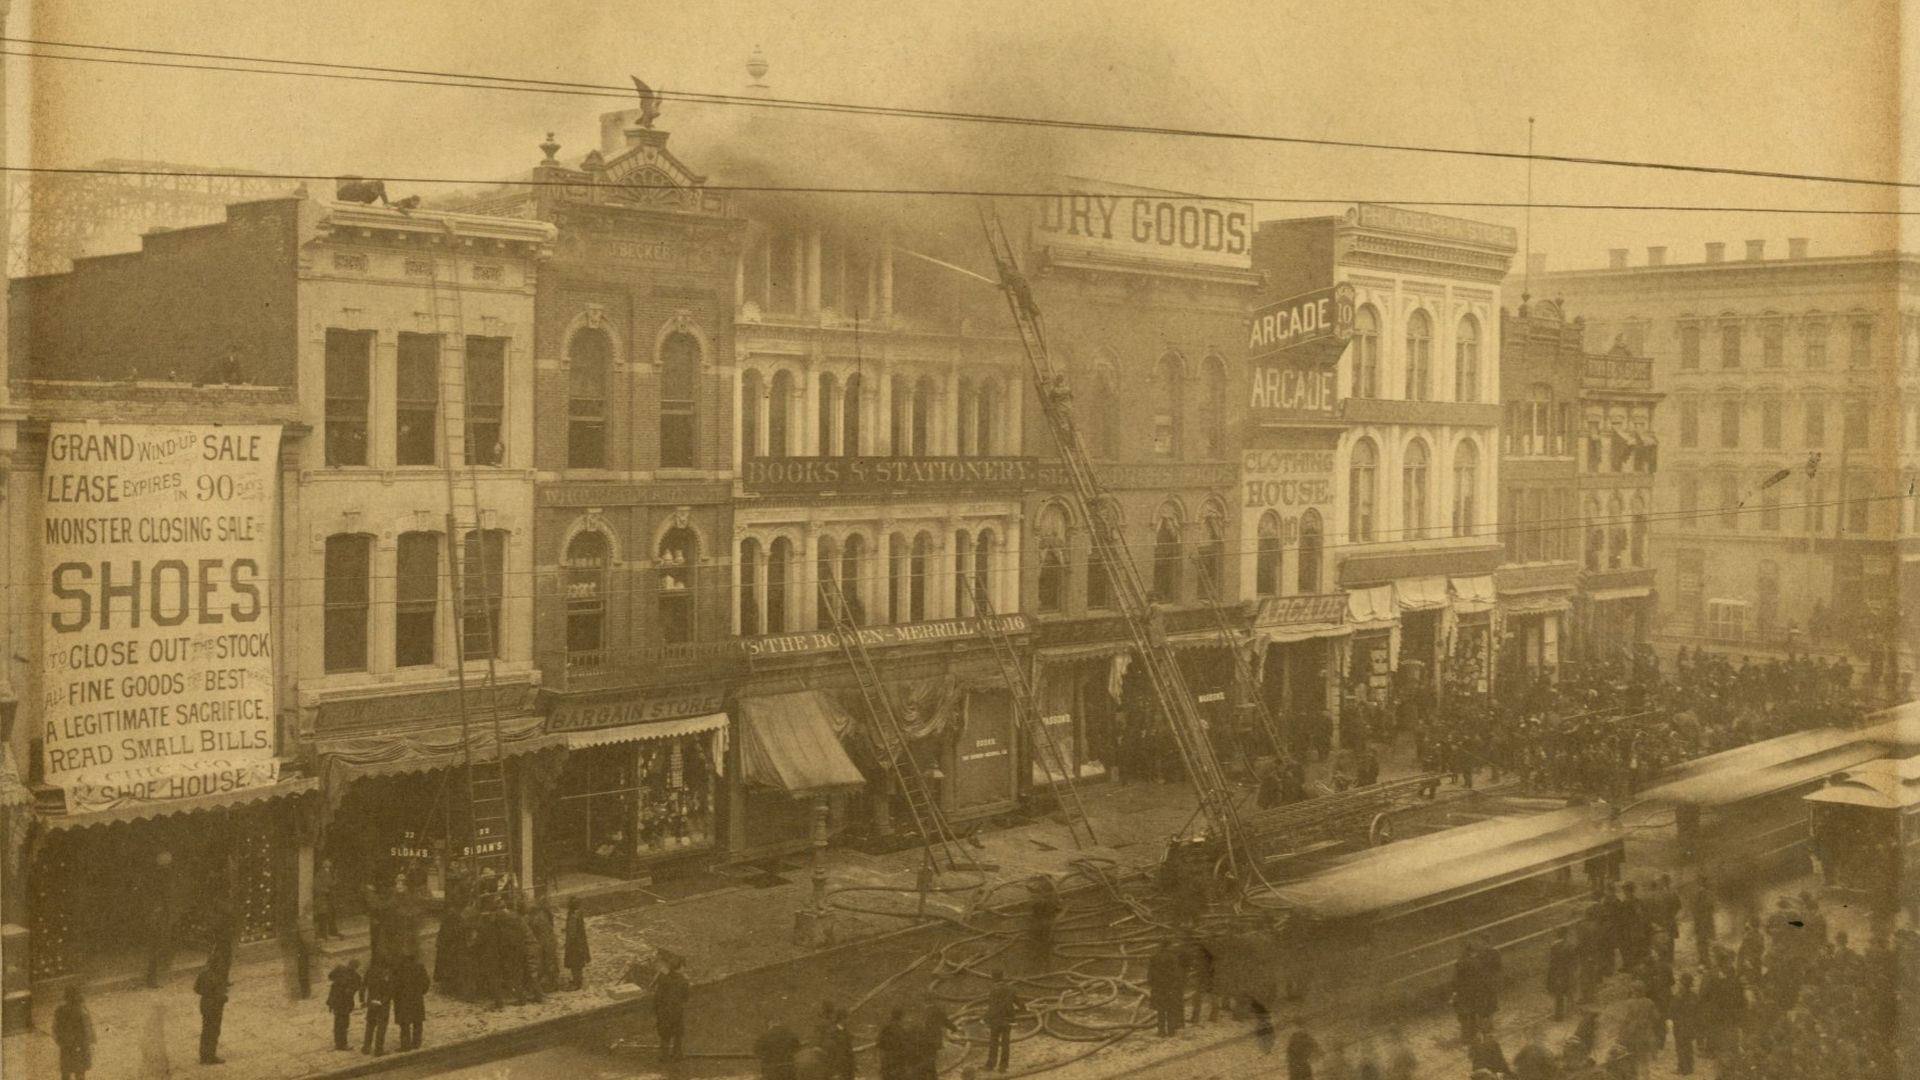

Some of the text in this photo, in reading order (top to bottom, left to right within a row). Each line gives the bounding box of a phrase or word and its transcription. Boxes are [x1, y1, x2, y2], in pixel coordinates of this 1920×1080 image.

[1037, 187, 1121, 240] DRY
[1249, 298, 1331, 349] ARCADE
[1337, 303, 1353, 323] 10
[1250, 367, 1333, 411] ARCADE
[51, 434, 261, 462] GRAND WIND-UP SALE
[1244, 452, 1334, 474] CLOTHING
[47, 474, 119, 502] LEASE
[123, 473, 182, 498] EXPIRES
[197, 474, 234, 501] 90
[748, 462, 839, 482] BOOKS
[46, 517, 132, 544] MONSTER
[139, 516, 212, 543] CLOSING
[217, 516, 255, 541] SALE
[52, 559, 261, 634] SHOES
[49, 650, 68, 669] TO
[69, 641, 138, 669] CLOSE
[150, 638, 191, 663] OUT
[216, 633, 270, 659] STOCK
[763, 636, 808, 653] THE
[69, 679, 115, 705] FINE
[121, 673, 184, 698] GOODS
[205, 668, 247, 691] BEST
[46, 699, 269, 744] A LEGITIMATE SACRIFICE.
[553, 697, 713, 729] BARGAIN STORE
[49, 729, 272, 773] READ SMALL BILLS.
